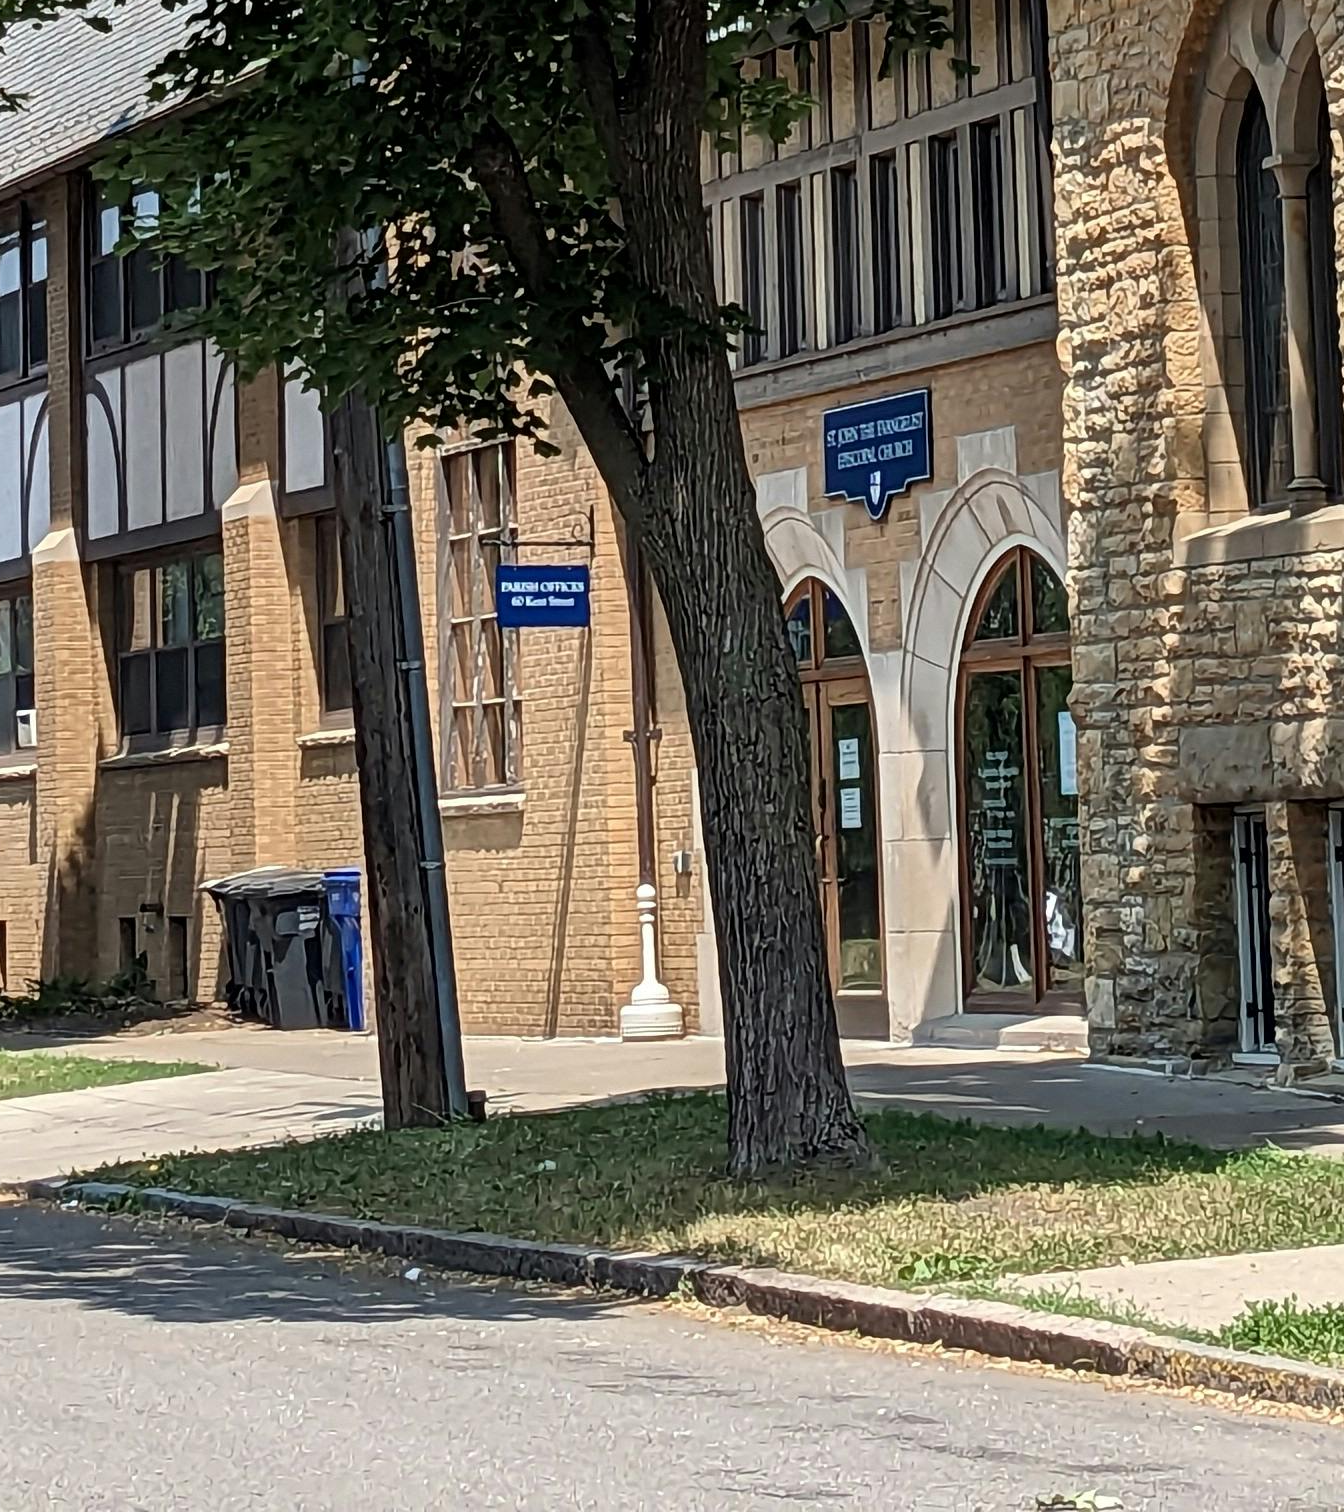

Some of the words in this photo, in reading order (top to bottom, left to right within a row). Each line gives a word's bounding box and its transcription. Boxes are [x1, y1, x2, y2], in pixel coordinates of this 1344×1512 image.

[878, 439, 913, 461] CHURCH
[501, 581, 539, 593] PARISH
[539, 581, 585, 593] OFFICES
